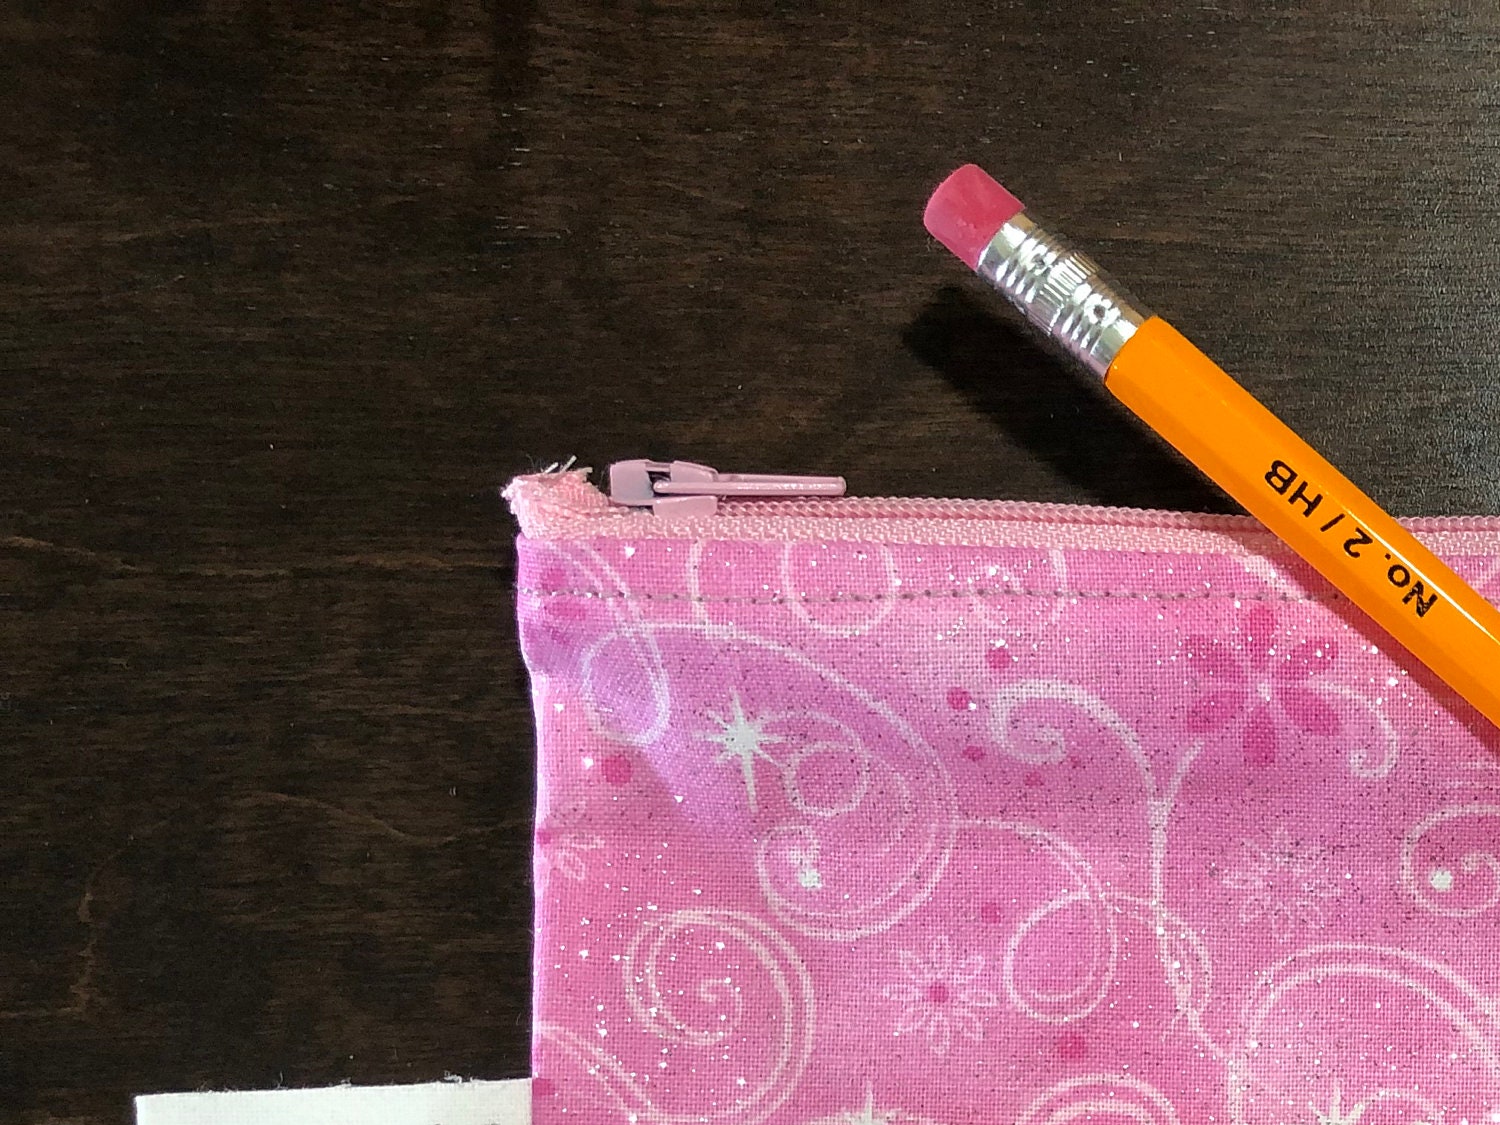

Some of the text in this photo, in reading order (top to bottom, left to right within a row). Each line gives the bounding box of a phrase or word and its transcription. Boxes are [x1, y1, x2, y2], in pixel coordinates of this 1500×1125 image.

[1264, 459, 1439, 618] No. 2 / HB
